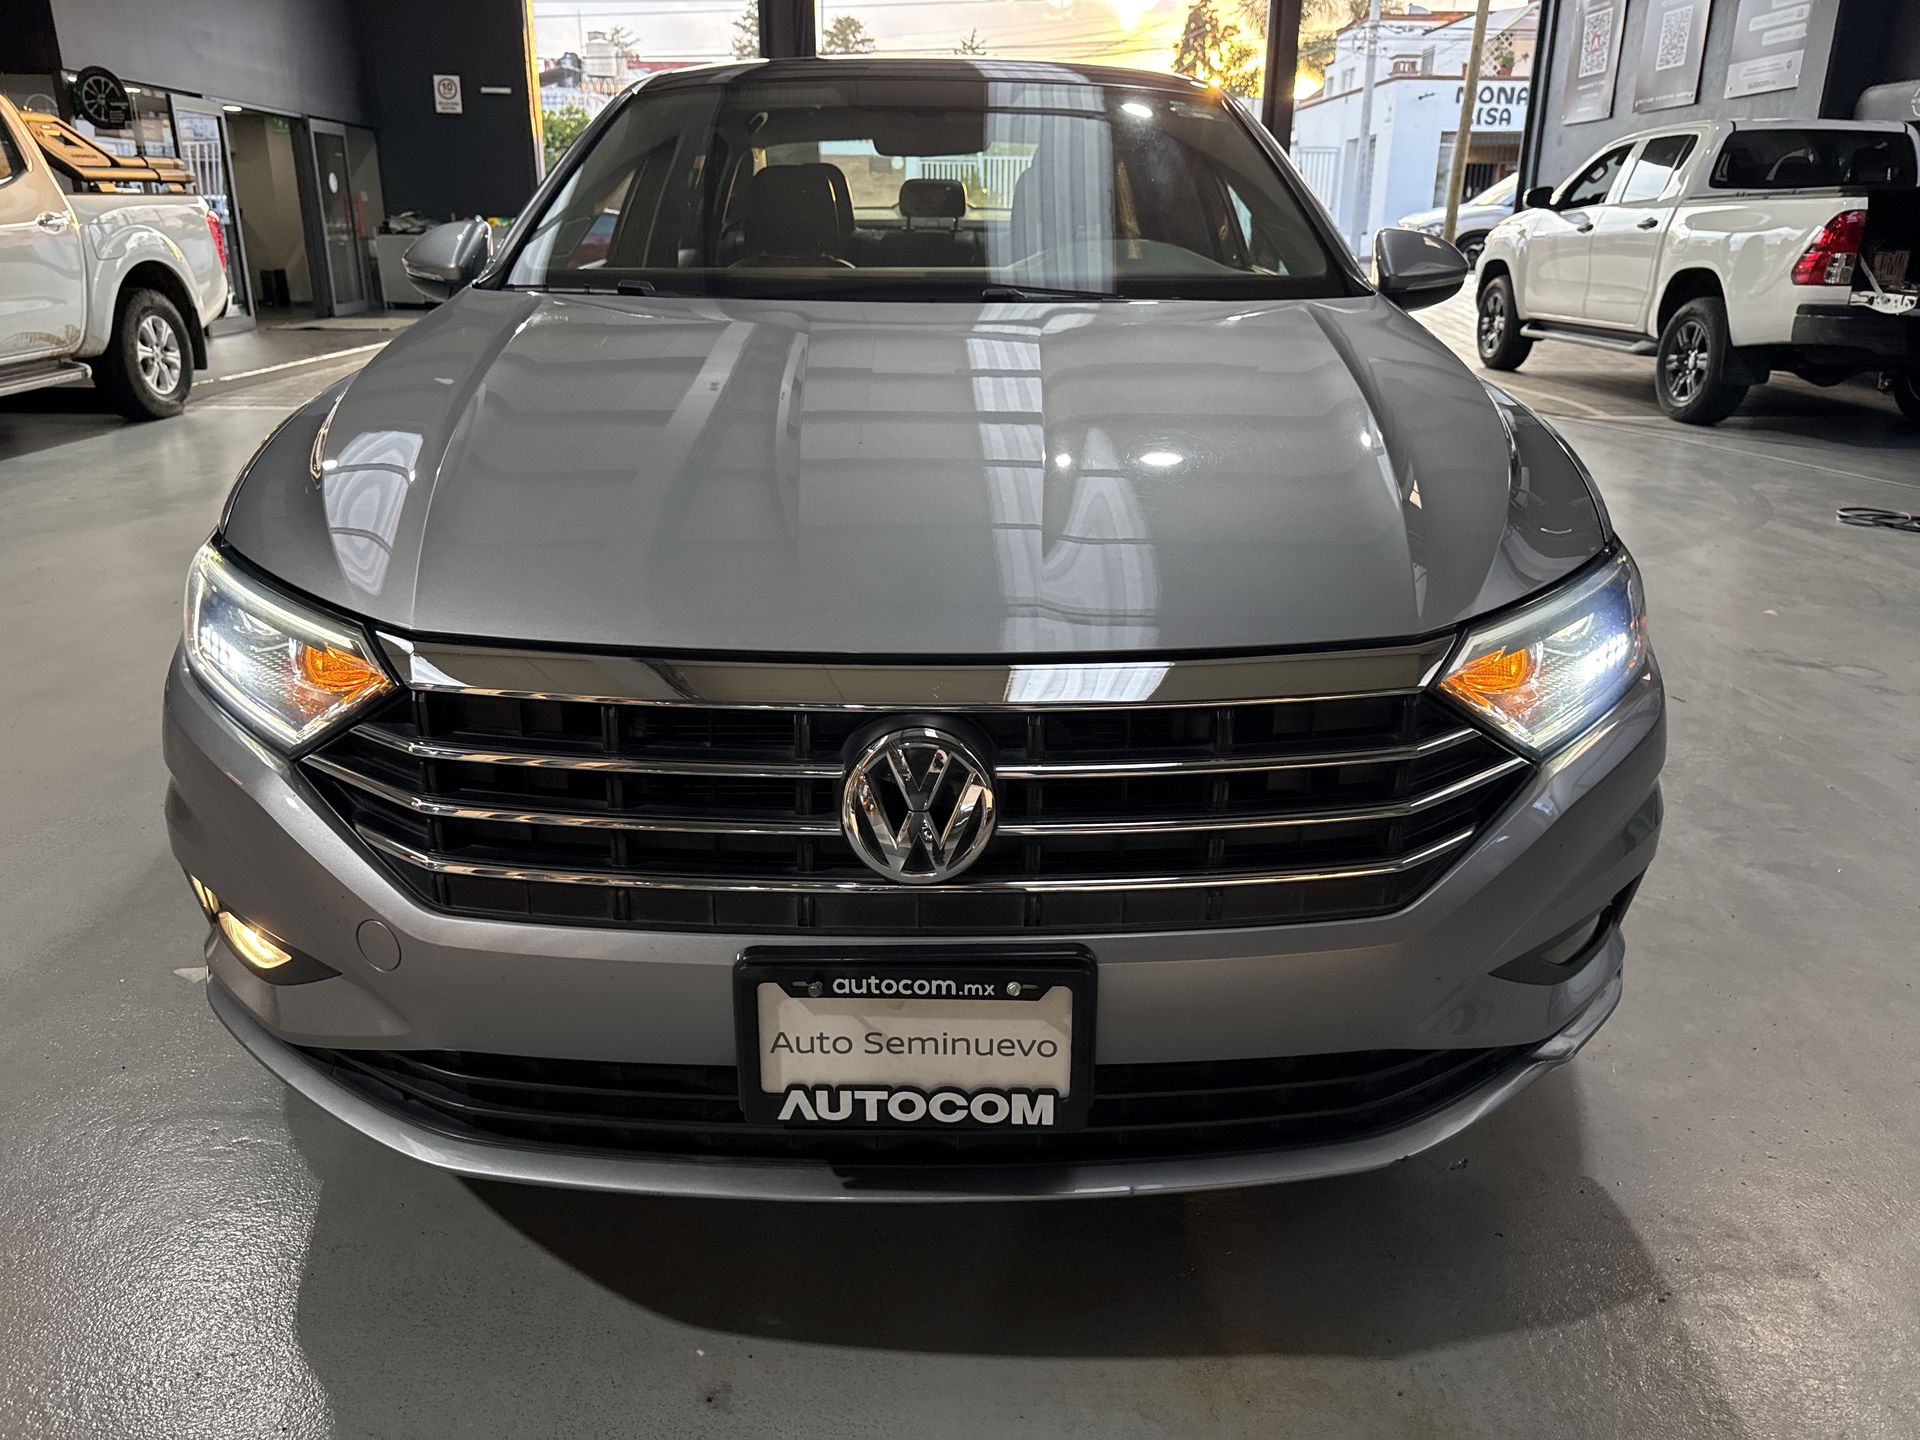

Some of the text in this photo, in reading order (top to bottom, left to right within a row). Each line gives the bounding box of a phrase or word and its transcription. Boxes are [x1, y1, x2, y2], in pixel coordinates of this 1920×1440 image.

[832, 975, 995, 996] autocom.mx
[770, 1031, 1058, 1058] Auto Seminuevo
[777, 1089, 1055, 1126] AUTOCOM
